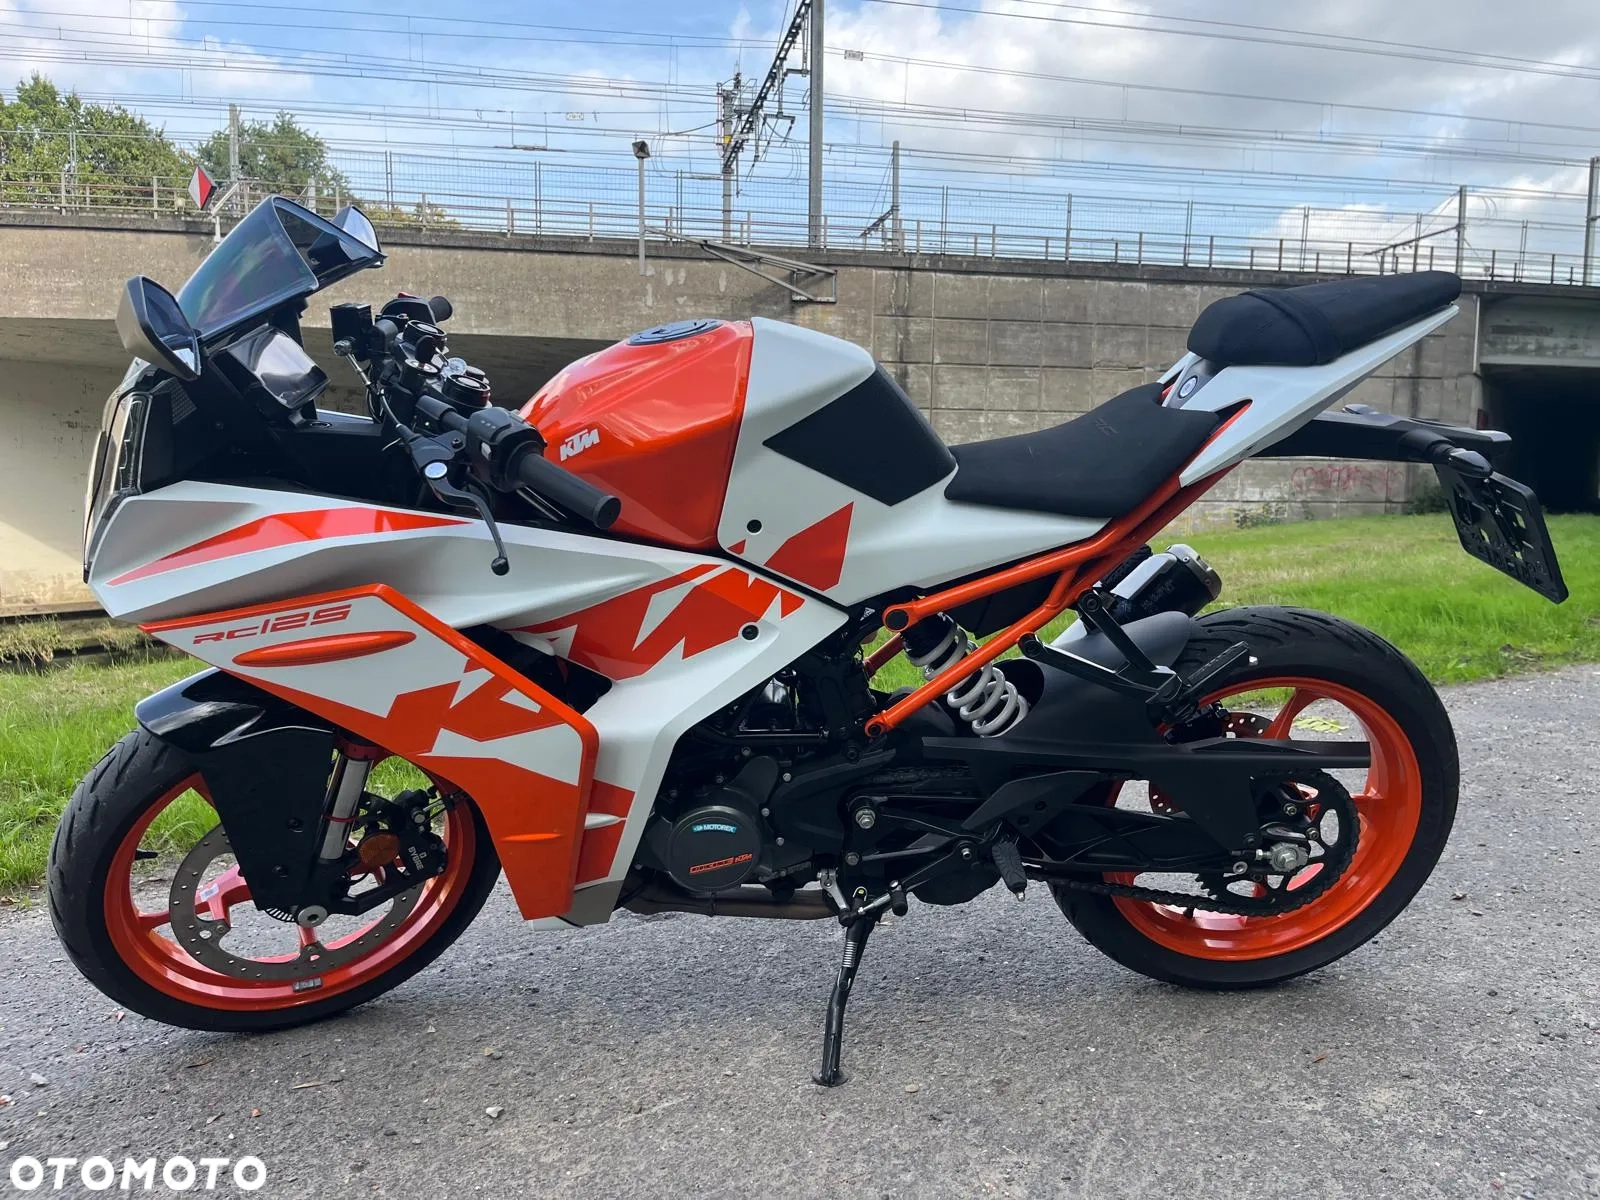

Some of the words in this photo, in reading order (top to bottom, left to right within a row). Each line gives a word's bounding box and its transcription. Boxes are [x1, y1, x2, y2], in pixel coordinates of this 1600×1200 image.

[559, 428, 600, 462] KTM
[193, 604, 352, 645] RC125
[703, 824, 737, 833] MOTOREX
